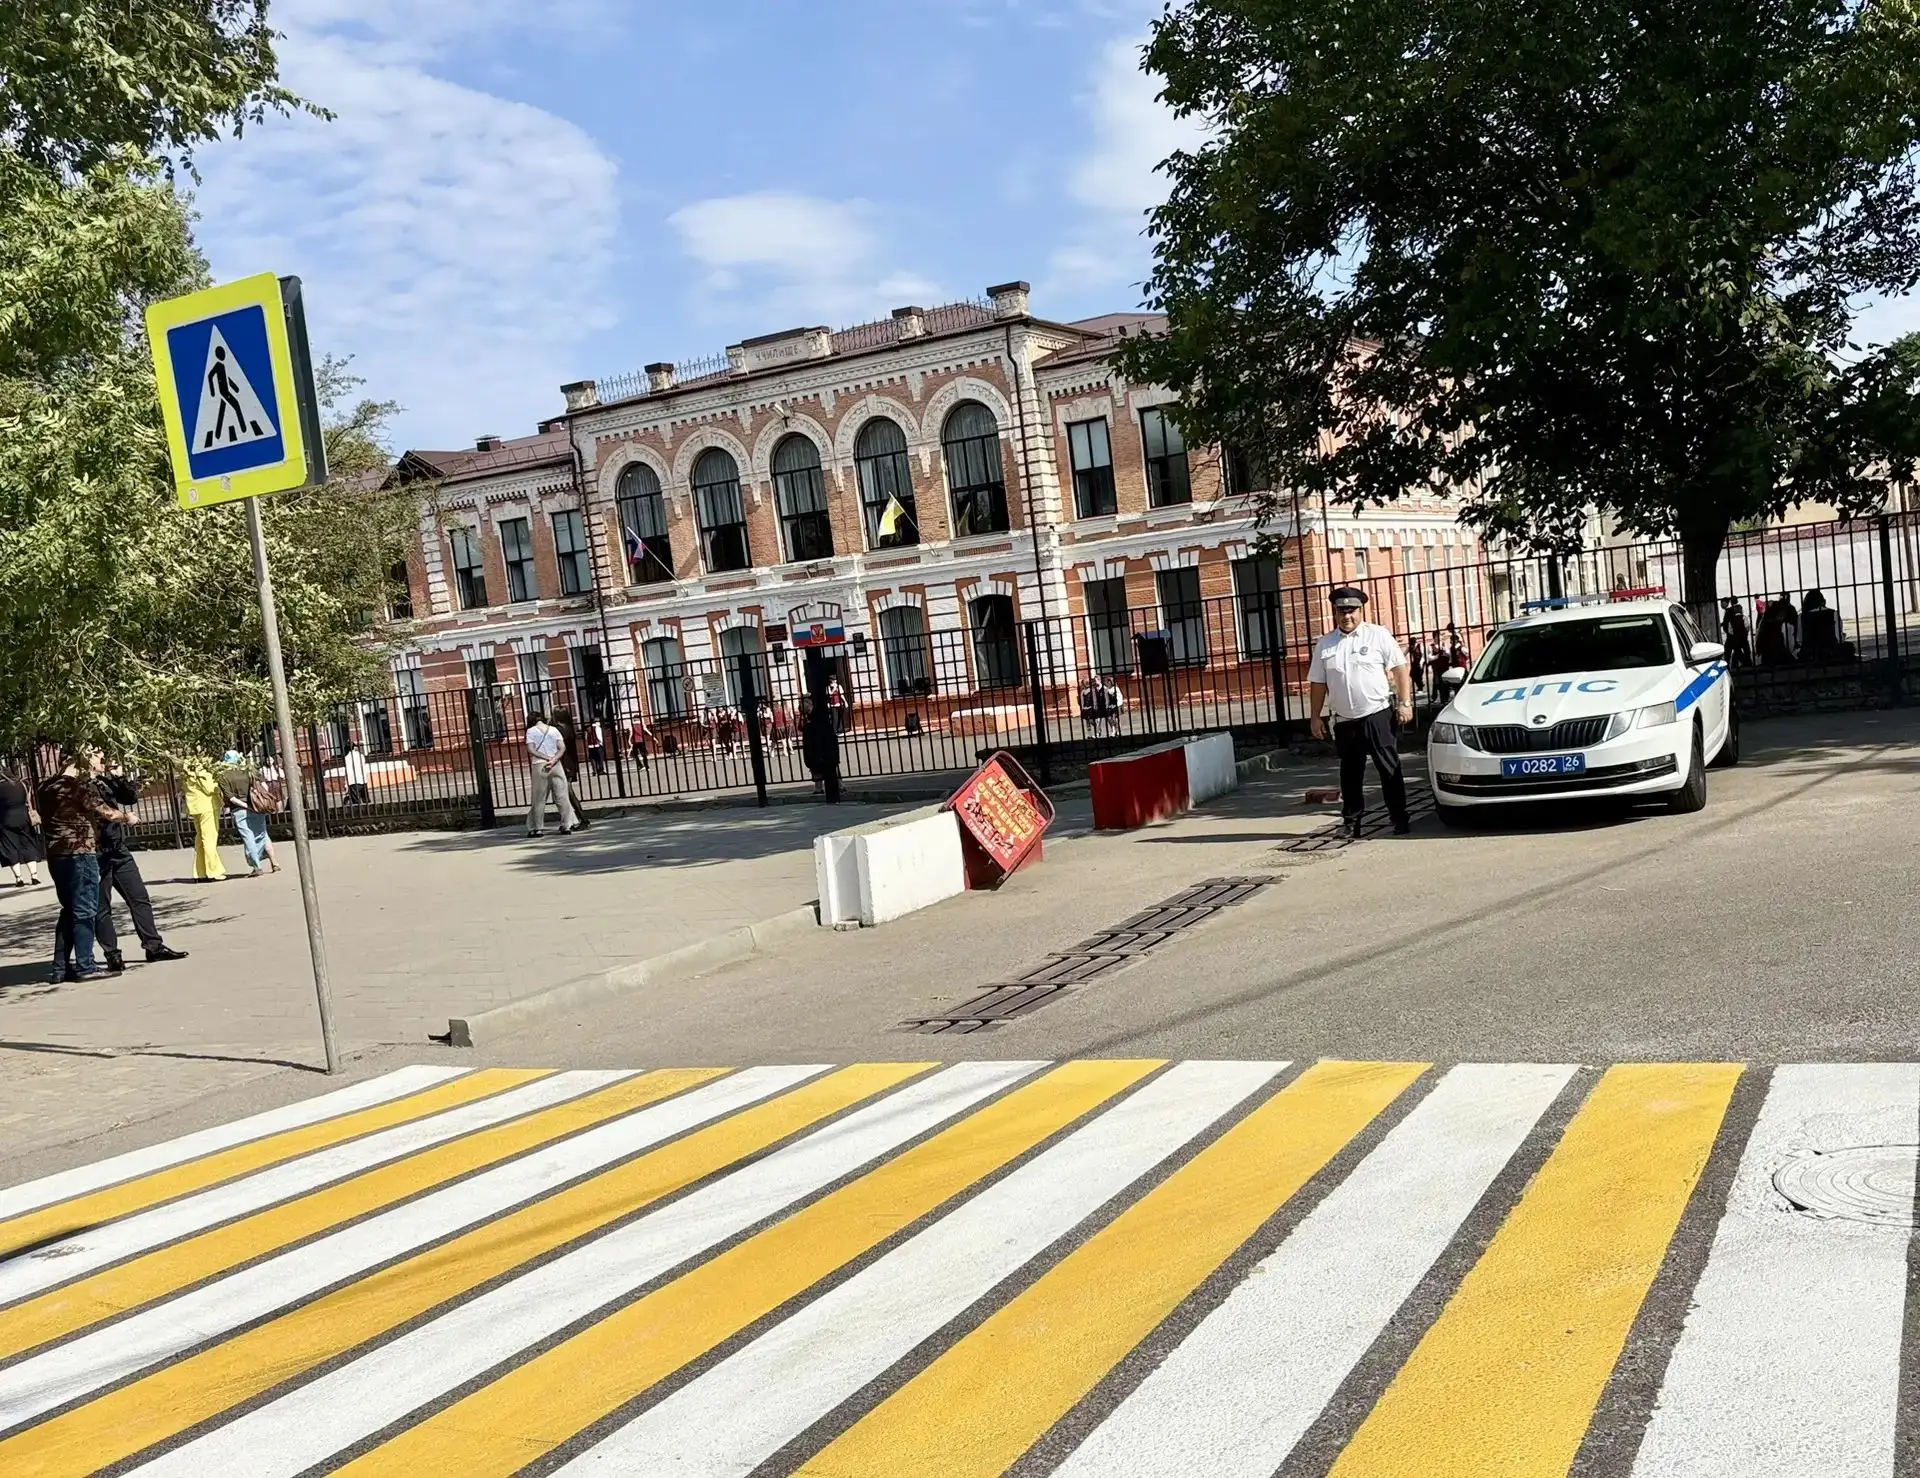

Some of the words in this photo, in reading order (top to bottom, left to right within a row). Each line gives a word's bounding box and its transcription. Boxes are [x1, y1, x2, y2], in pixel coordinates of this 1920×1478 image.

[1481, 680, 1619, 706] ДПС
[1522, 758, 1557, 773] 0282
[1565, 756, 1580, 767] 26
[975, 781, 1027, 842] ОБУЧЕНИЕ
